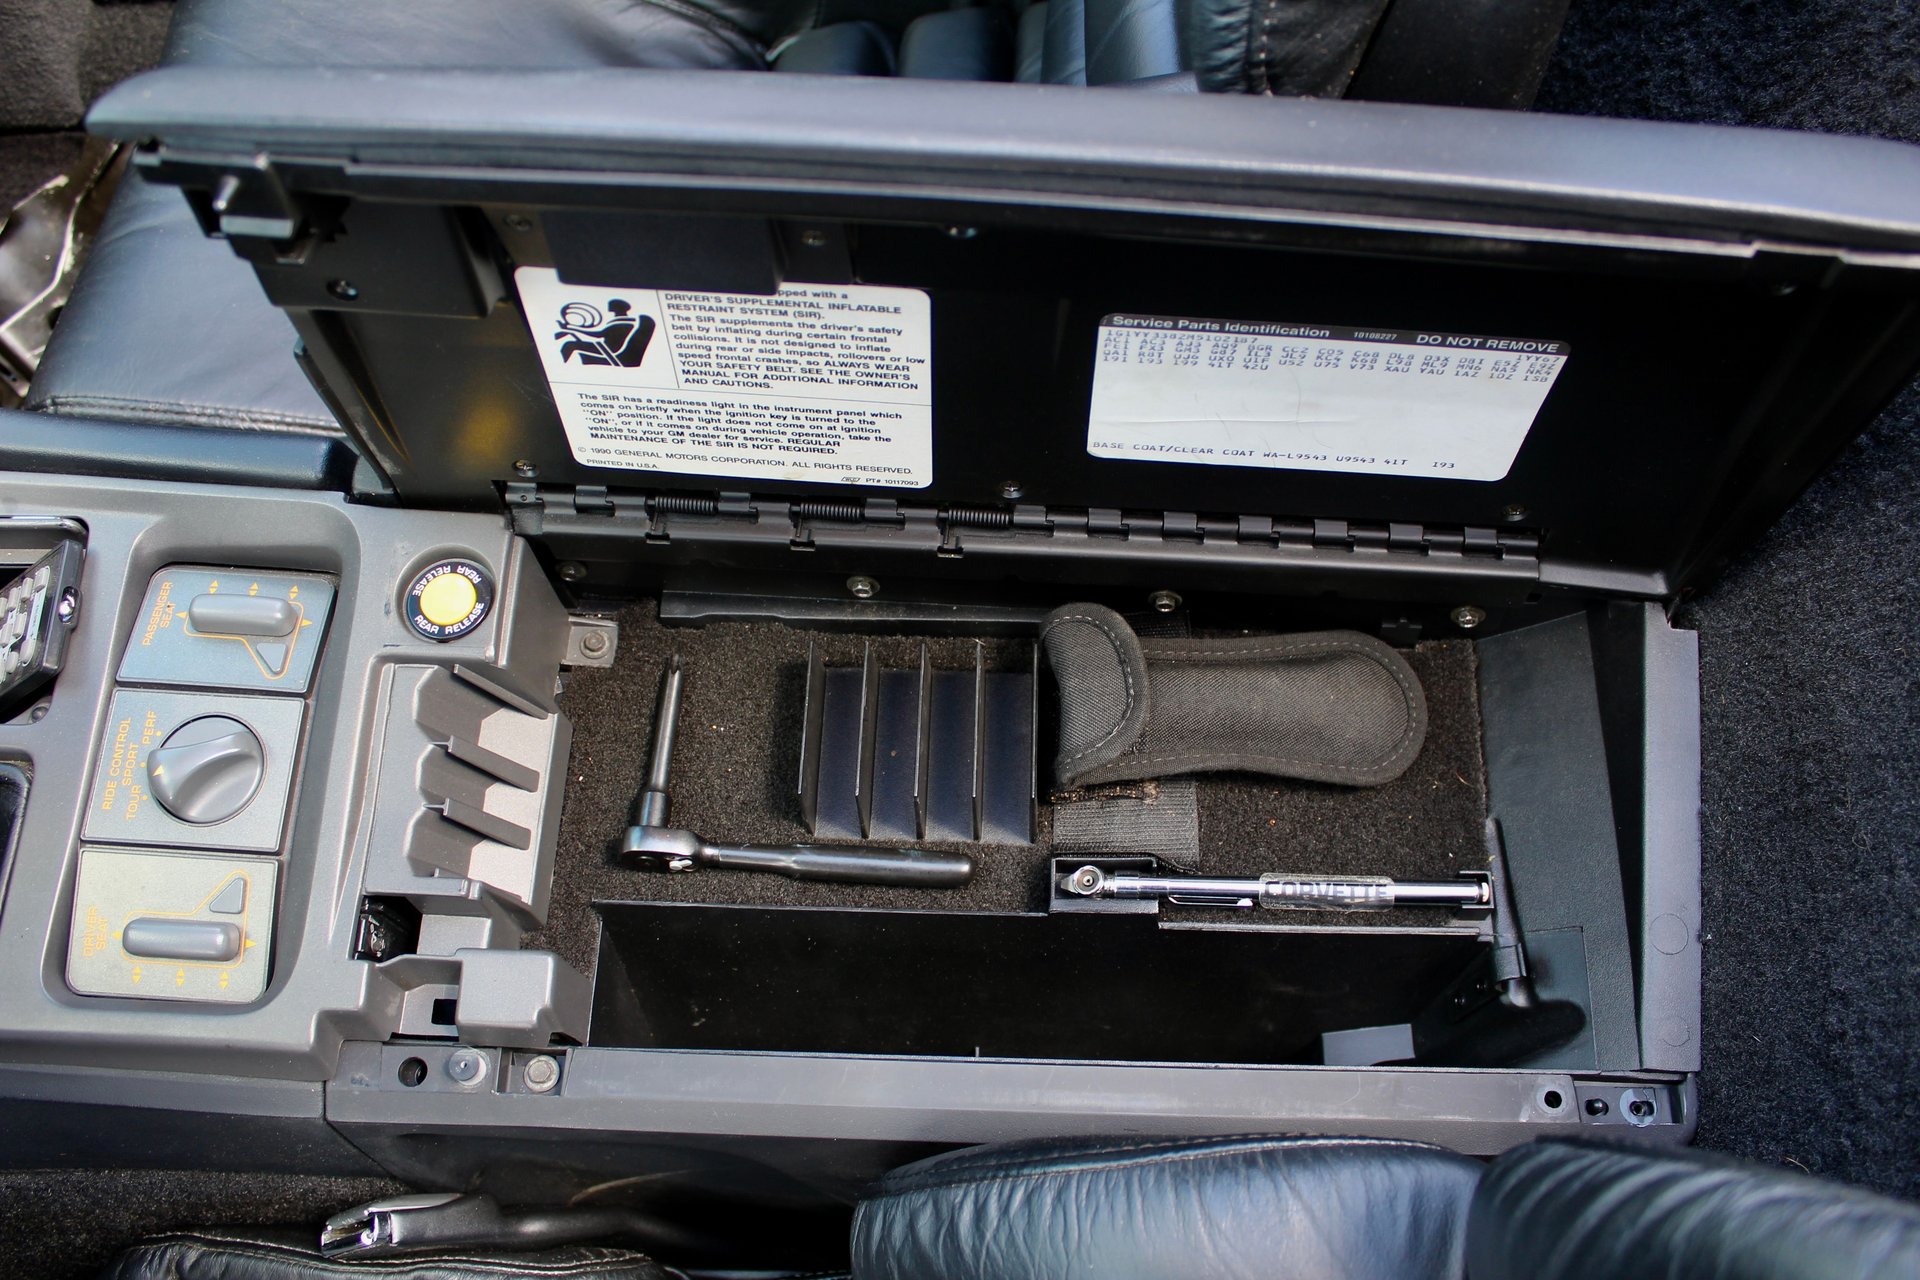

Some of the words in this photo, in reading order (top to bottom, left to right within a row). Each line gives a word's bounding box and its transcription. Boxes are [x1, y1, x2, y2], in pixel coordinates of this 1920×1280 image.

[664, 292, 722, 303] DRIVER'S
[726, 296, 823, 309] SUPPLEMENTAL
[827, 302, 901, 314] INFLATABLE
[811, 290, 836, 298] with
[666, 302, 734, 313] RESTRAINT
[739, 306, 788, 316] SYSTEM
[792, 310, 824, 320] (SIR).
[669, 313, 691, 322] The
[694, 314, 715, 323] SIR
[719, 317, 794, 328] supplements
[796, 321, 816, 329] the
[819, 322, 864, 332] driver's
[867, 326, 903, 336] safety
[670, 323, 693, 331] belt
[696, 324, 710, 334] by
[714, 325, 761, 337] inflating
[764, 328, 803, 339] during
[806, 332, 846, 340] certain
[850, 333, 887, 343] frontal
[1112, 315, 1173, 328] Service
[1177, 319, 1220, 331] Parts
[1224, 321, 1330, 337] Identification
[672, 333, 730, 342] collisions.
[734, 335, 742, 343] It
[746, 336, 757, 344] is
[760, 338, 779, 346] not
[782, 339, 836, 349] designed
[839, 342, 851, 350] to
[854, 343, 891, 353] inflate
[675, 341, 712, 352] during
[757, 346, 781, 354] side
[785, 348, 833, 359] impacts,
[837, 352, 886, 361] rollovers
[905, 355, 925, 364] low
[1415, 334, 1442, 344] DO
[1445, 335, 1483, 347] NOT
[1485, 338, 1559, 353] REMOVE
[677, 351, 711, 361] speed
[714, 352, 751, 362] frontal
[754, 356, 802, 366] crashes,
[823, 359, 870, 369] ALWAYS
[873, 362, 910, 372] WEAR
[679, 359, 712, 368] YOUR
[715, 361, 760, 371] SAFETY
[765, 364, 795, 373] BELT.
[799, 366, 822, 375] SEE
[827, 368, 851, 377] THE
[854, 370, 910, 381] OWNER'S
[681, 368, 730, 378] MANUAL
[733, 371, 758, 379] FOR
[762, 373, 833, 384] ADDITIONAL
[837, 378, 918, 390] INFORMATION
[683, 376, 708, 384] AND
[711, 378, 773, 389] CAUTIONS.
[577, 392, 598, 400] The
[622, 395, 642, 403] has
[655, 398, 707, 407] readiness
[710, 400, 735, 409] light
[752, 403, 770, 411] the
[773, 404, 832, 415] instrument
[835, 409, 866, 417] panel
[869, 411, 902, 419] which
[634, 404, 668, 414] briefly
[671, 406, 701, 414] when
[703, 408, 721, 416] the
[725, 409, 766, 418] ignition
[769, 412, 787, 421] key
[804, 414, 840, 423] turned
[616, 412, 662, 420] position.
[676, 414, 694, 422] the
[697, 416, 721, 424] light
[724, 417, 751, 426] does
[840, 424, 881, 434] ignition
[656, 422, 691, 430] comes
[711, 424, 746, 434] during
[749, 427, 787, 436] vehicle
[790, 430, 844, 440] operation,
[847, 433, 870, 441] take
[587, 425, 623, 433] vehicle
[640, 429, 663, 438] your
[666, 429, 685, 437] GM
[688, 431, 720, 439] dealer
[742, 435, 783, 443] service.
[786, 437, 840, 447] REGULAR
[589, 432, 668, 443] MAINTENANCE
[689, 438, 712, 446] THE
[715, 440, 734, 448] SIR
[751, 442, 774, 450] NOT
[777, 444, 837, 454] REQUIRED.
[1092, 441, 1125, 449] BASE
[1132, 444, 1213, 454] COAT/CLEAR
[1222, 448, 1254, 456] COAT
[585, 458, 623, 466] PRINTED
[613, 448, 662, 458] GENERAL
[664, 452, 708, 461] MOTORS
[710, 455, 787, 466] CORPORATION.
[791, 460, 810, 468] ALL
[813, 461, 852, 471] RIGHTS
[855, 464, 912, 474] RESERVED.
[412, 565, 451, 597] RELEASE
[456, 565, 482, 584] REAR
[142, 582, 174, 646] PASSENGER
[160, 602, 176, 628] SEAT
[414, 615, 439, 634] REAR
[445, 602, 484, 634] RELEASE
[142, 710, 157, 745] PERF
[102, 780, 117, 810] RIDE
[110, 717, 131, 777] CONTROL
[122, 743, 139, 786] SPORT
[126, 784, 142, 820] TOUR
[82, 905, 97, 957] DRIVER
